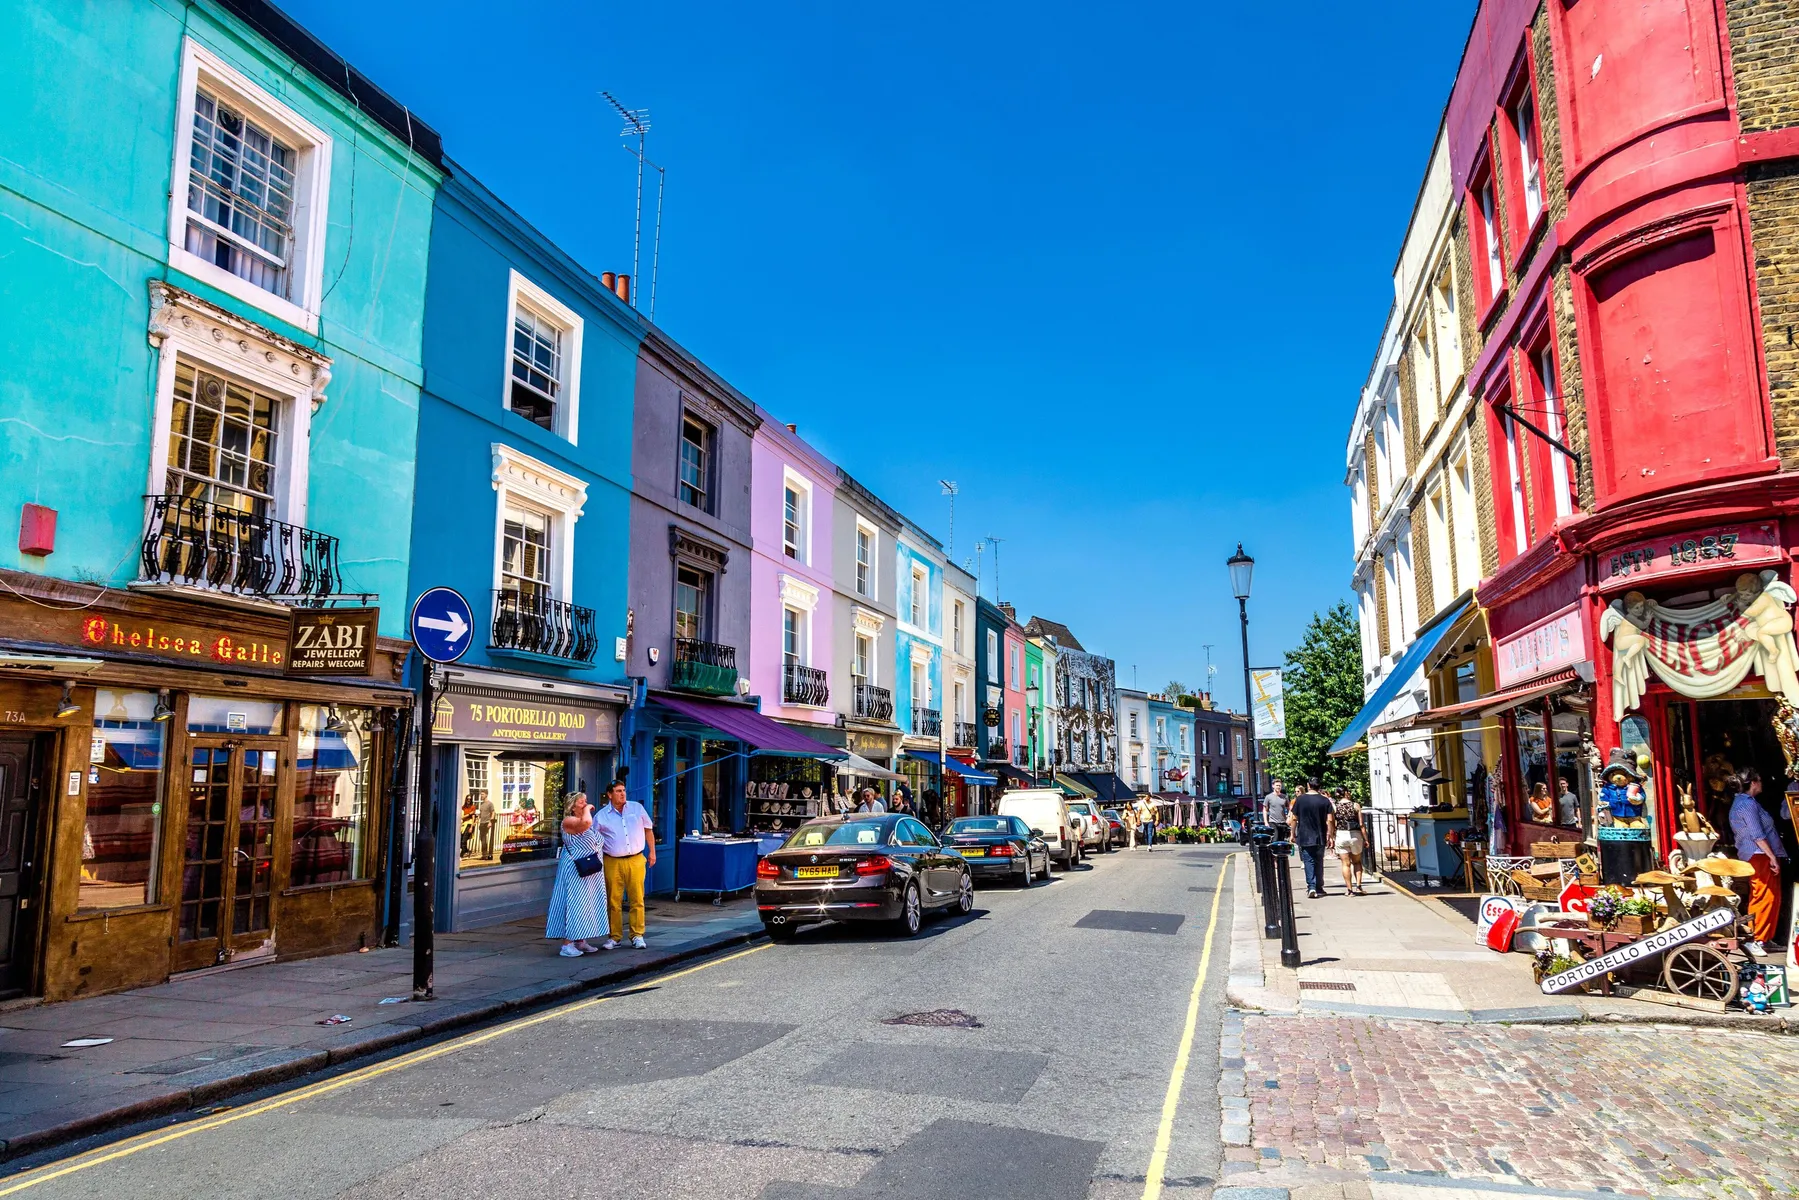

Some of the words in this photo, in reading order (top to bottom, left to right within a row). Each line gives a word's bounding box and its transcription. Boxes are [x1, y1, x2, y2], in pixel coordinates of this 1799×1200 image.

[87, 617, 202, 655] Chelsea
[217, 636, 283, 665] Galle
[294, 625, 366, 649] ZABI
[303, 649, 363, 658] JEWELLERY
[292, 660, 325, 668] REPAIRS
[327, 660, 366, 668] WELCOME
[5, 711, 26, 722] 73A
[470, 704, 483, 722] 75
[485, 705, 557, 728] PORTOBELLO
[558, 711, 586, 729] ROAD
[492, 729, 531, 739] ANTIQUES
[533, 731, 567, 740] GALLERY
[822, 866, 838, 876] HAU
[1547, 947, 1640, 991] PORTOBELLO
[1645, 927, 1689, 952] ROAD
[1692, 912, 1727, 933] W.11
